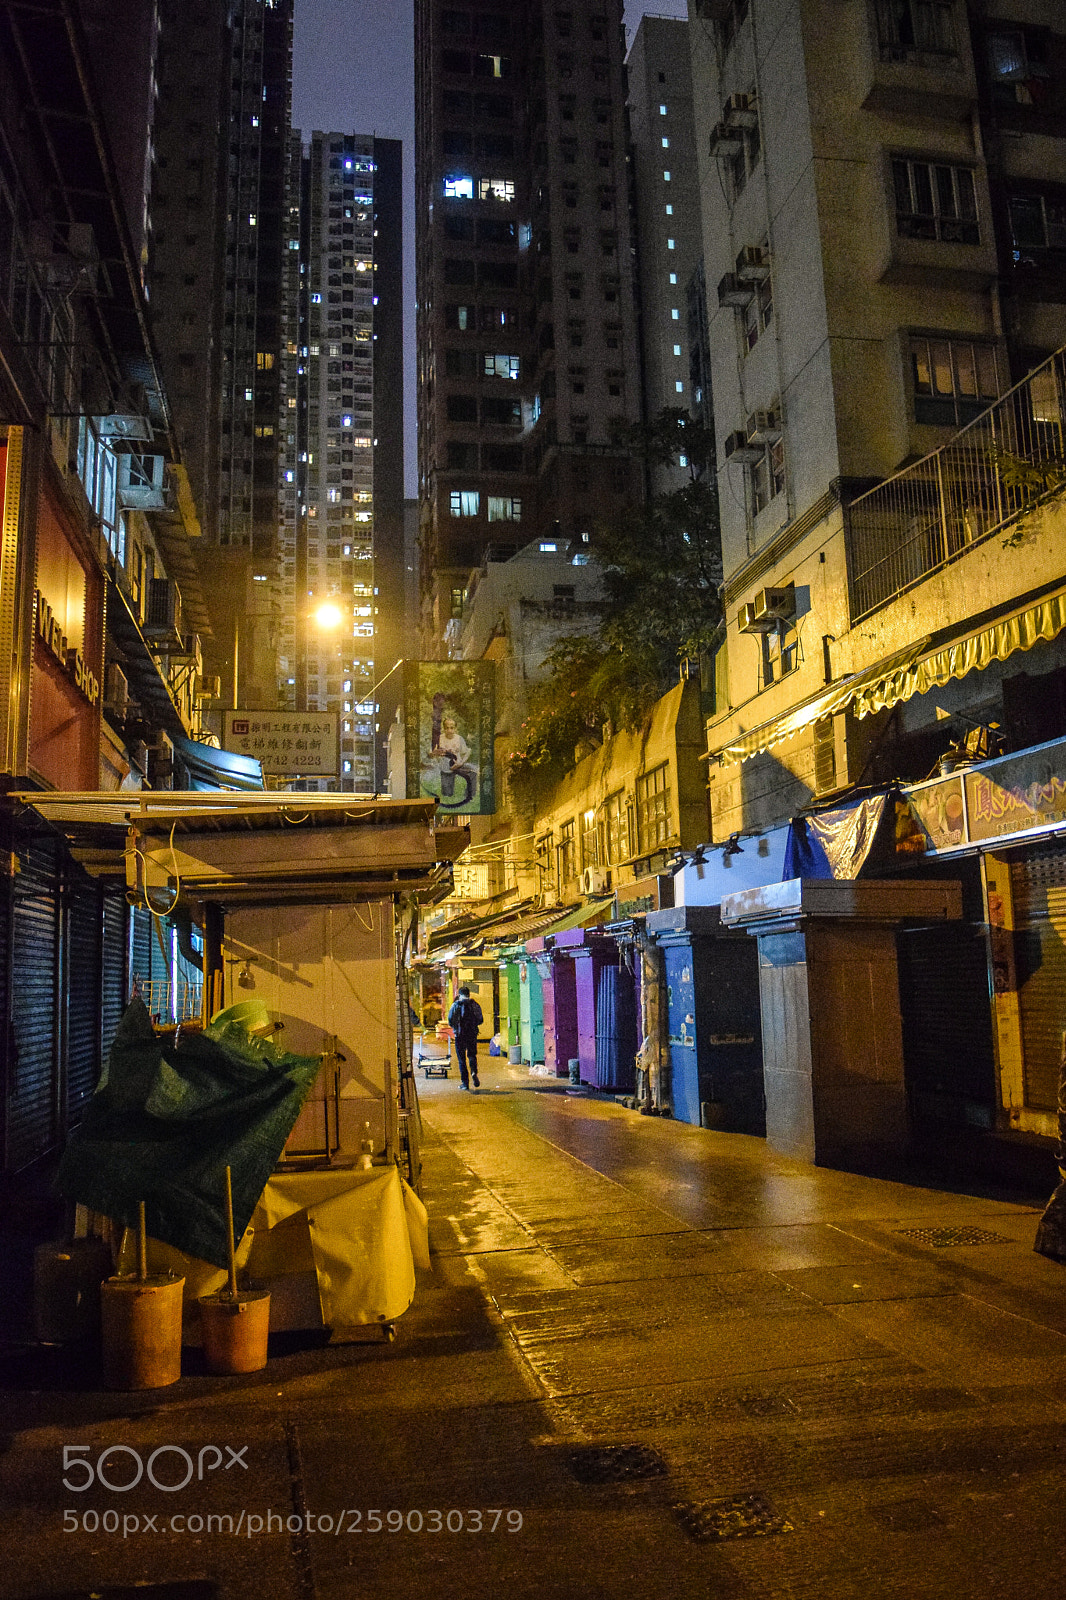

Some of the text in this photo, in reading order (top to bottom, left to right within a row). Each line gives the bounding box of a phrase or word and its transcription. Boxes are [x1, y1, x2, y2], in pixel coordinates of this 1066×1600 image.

[75, 649, 100, 706] SHOP
[258, 755, 322, 767] 2742 4223
